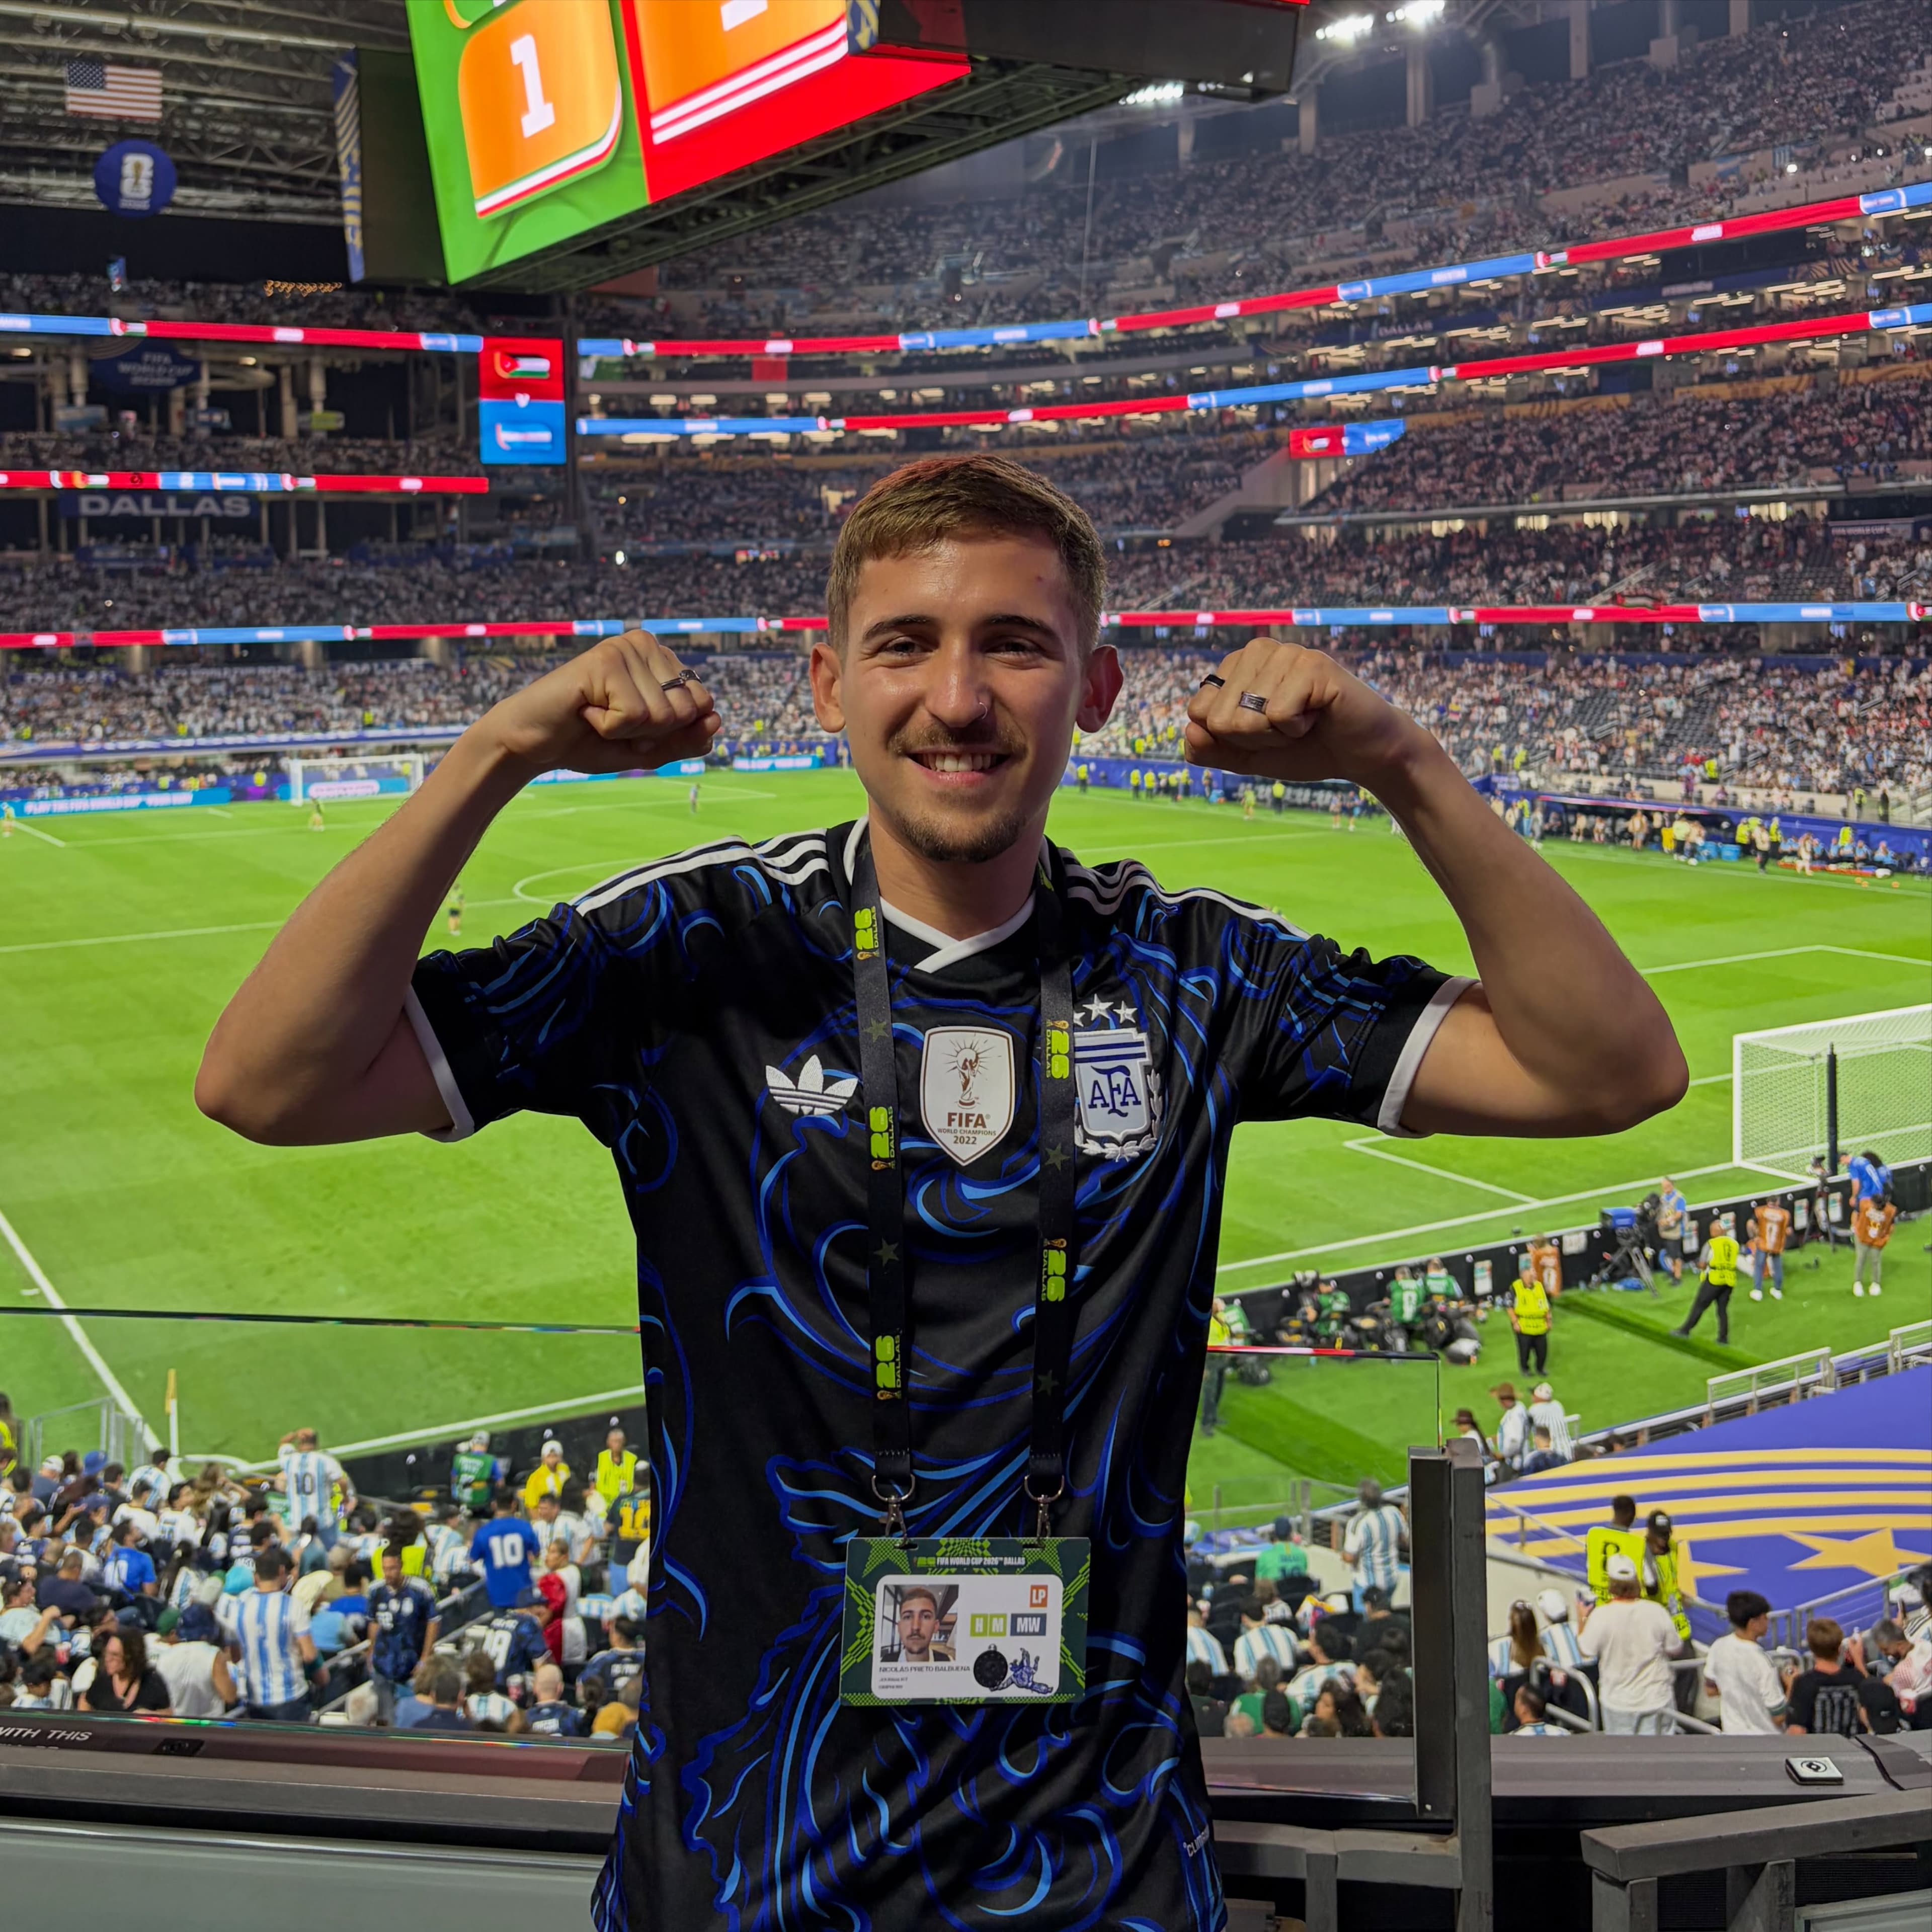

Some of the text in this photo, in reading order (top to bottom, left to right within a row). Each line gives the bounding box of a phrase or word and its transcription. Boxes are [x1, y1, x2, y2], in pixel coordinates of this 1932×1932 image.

[510, 34, 555, 138] 1
[79, 494, 251, 517] DALLAS
[871, 906, 879, 948] DALLAS
[1088, 1065, 1142, 1117] AFA
[953, 1136, 977, 1145] 2022
[489, 1533, 524, 1569] 10
[937, 1557, 948, 1565] FIFA
[950, 1557, 971, 1565] WORLD
[971, 1557, 983, 1565] CUP
[1004, 1557, 1025, 1566] DALLAS
[1032, 1588, 1046, 1604] LP
[975, 1617, 1041, 1633] H M MW
[47, 1730, 92, 1741] THIS
